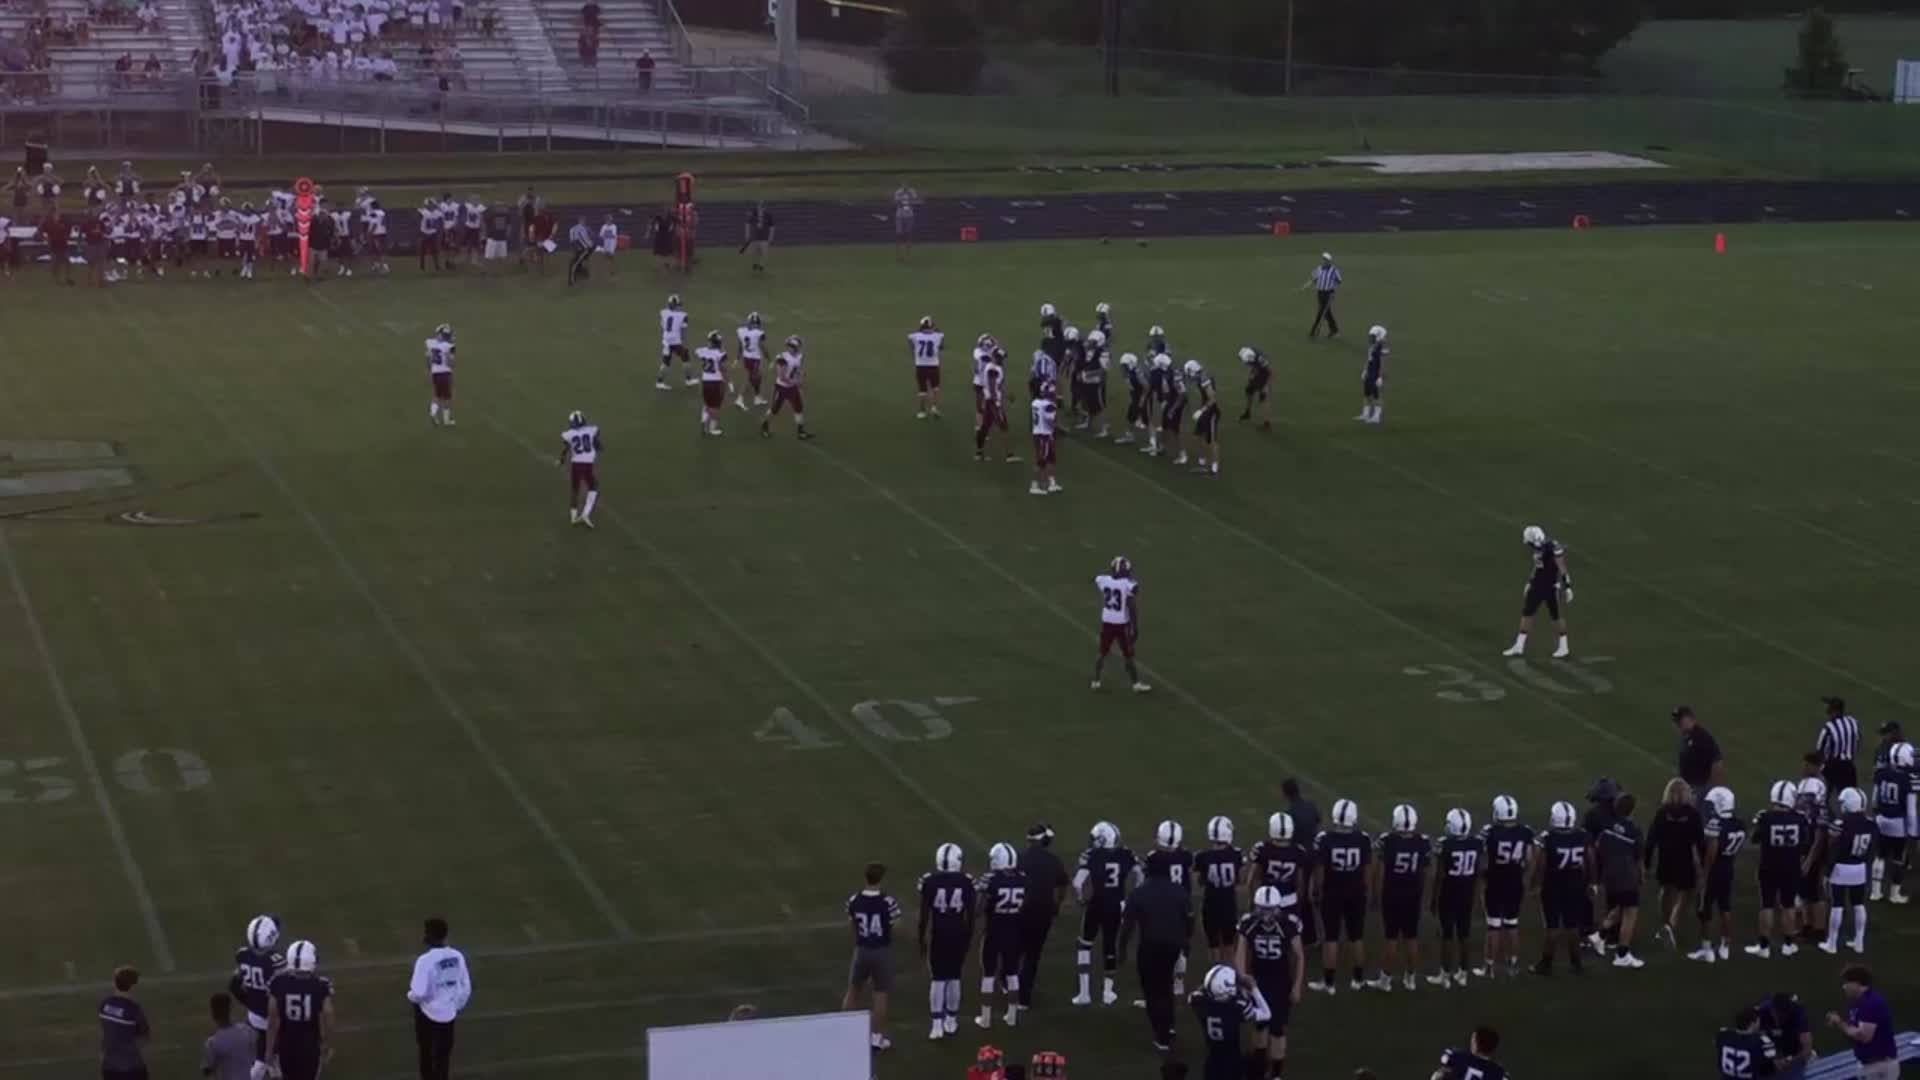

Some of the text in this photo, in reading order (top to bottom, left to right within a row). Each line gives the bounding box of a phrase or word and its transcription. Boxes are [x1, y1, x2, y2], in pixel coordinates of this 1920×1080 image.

[1103, 587, 1122, 611] 23
[752, 698, 954, 750] 40
[1770, 824, 1800, 847] 63
[1331, 848, 1361, 871] 50
[1394, 852, 1419, 873] 51
[1448, 851, 1477, 875] 30
[1496, 841, 1524, 867] 54
[1557, 847, 1585, 869] 75
[1104, 863, 1119, 888] 3
[1207, 863, 1236, 889] 40
[933, 888, 963, 912] 44
[995, 887, 1025, 913] 25
[855, 913, 883, 937] 34
[1254, 935, 1282, 960] 55
[240, 963, 266, 991] 20
[285, 993, 312, 1021] 61
[1206, 1017, 1223, 1040] 6
[1721, 1045, 1753, 1079] 62
